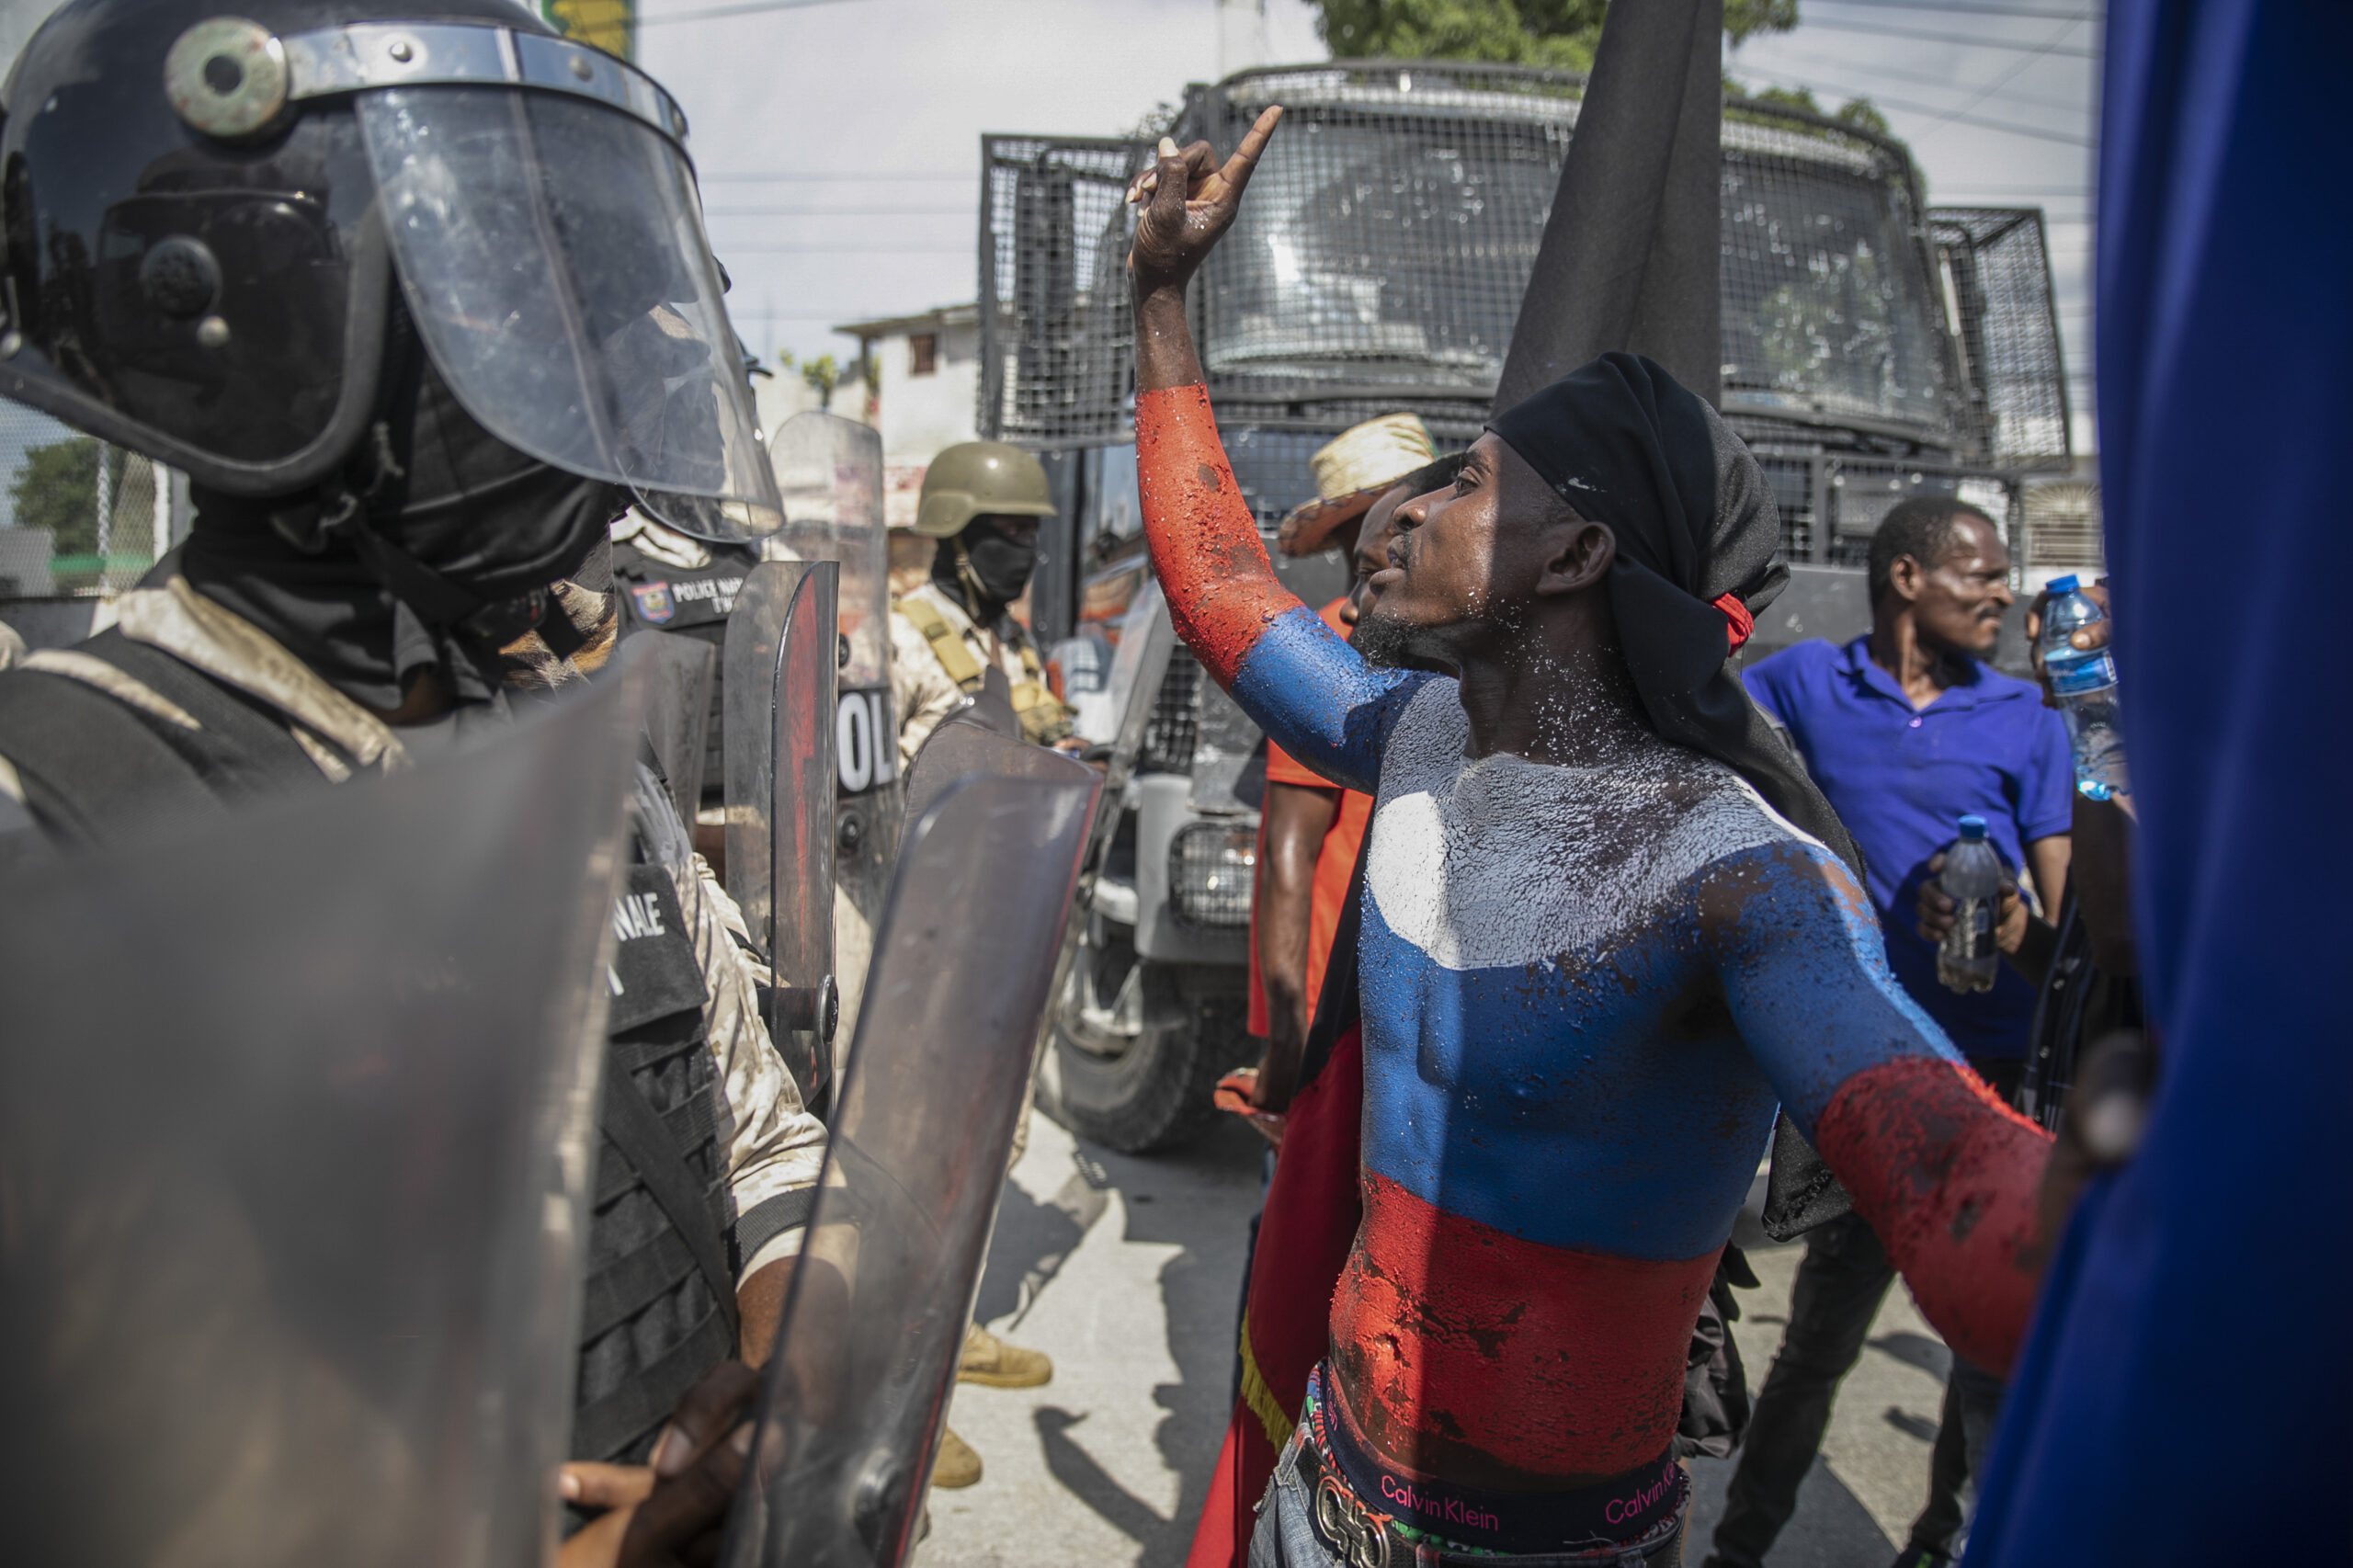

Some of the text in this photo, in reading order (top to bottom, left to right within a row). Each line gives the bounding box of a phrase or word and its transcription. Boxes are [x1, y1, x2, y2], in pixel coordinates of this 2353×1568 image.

[672, 578, 718, 603] POLICE
[1381, 1475, 1498, 1532] Calvin Klein
[1605, 1479, 1663, 1524] Calvin
